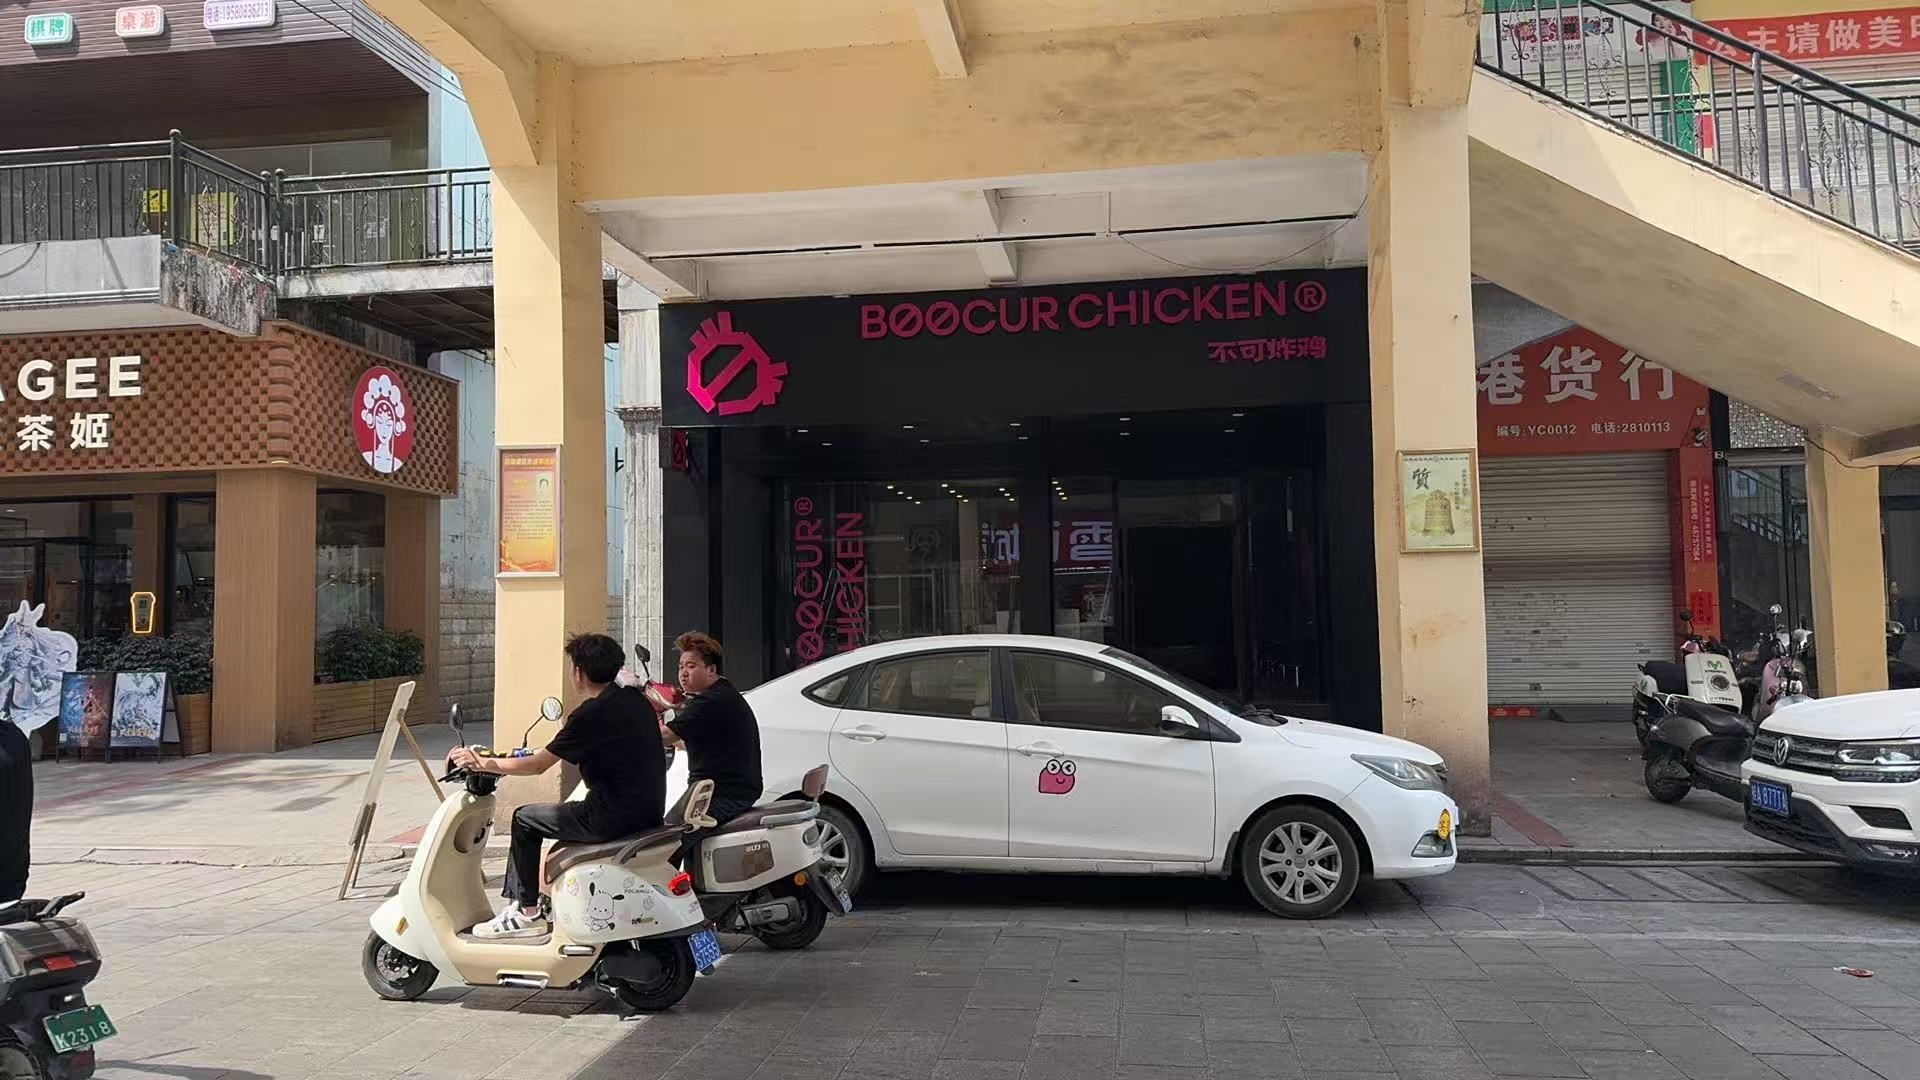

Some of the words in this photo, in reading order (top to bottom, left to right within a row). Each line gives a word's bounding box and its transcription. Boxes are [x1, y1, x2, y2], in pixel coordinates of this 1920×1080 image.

[31, 18, 64, 37] 棋牌
[121, 10, 156, 30] 桌游
[1068, 280, 1287, 329] CHICKEN
[1208, 336, 1327, 362] 不可炸鸡
[0, 355, 142, 401] GEE
[17, 412, 109, 451] 茶姬
[836, 513, 864, 653] HICKEN
[55, 1021, 111, 1049] K2318
